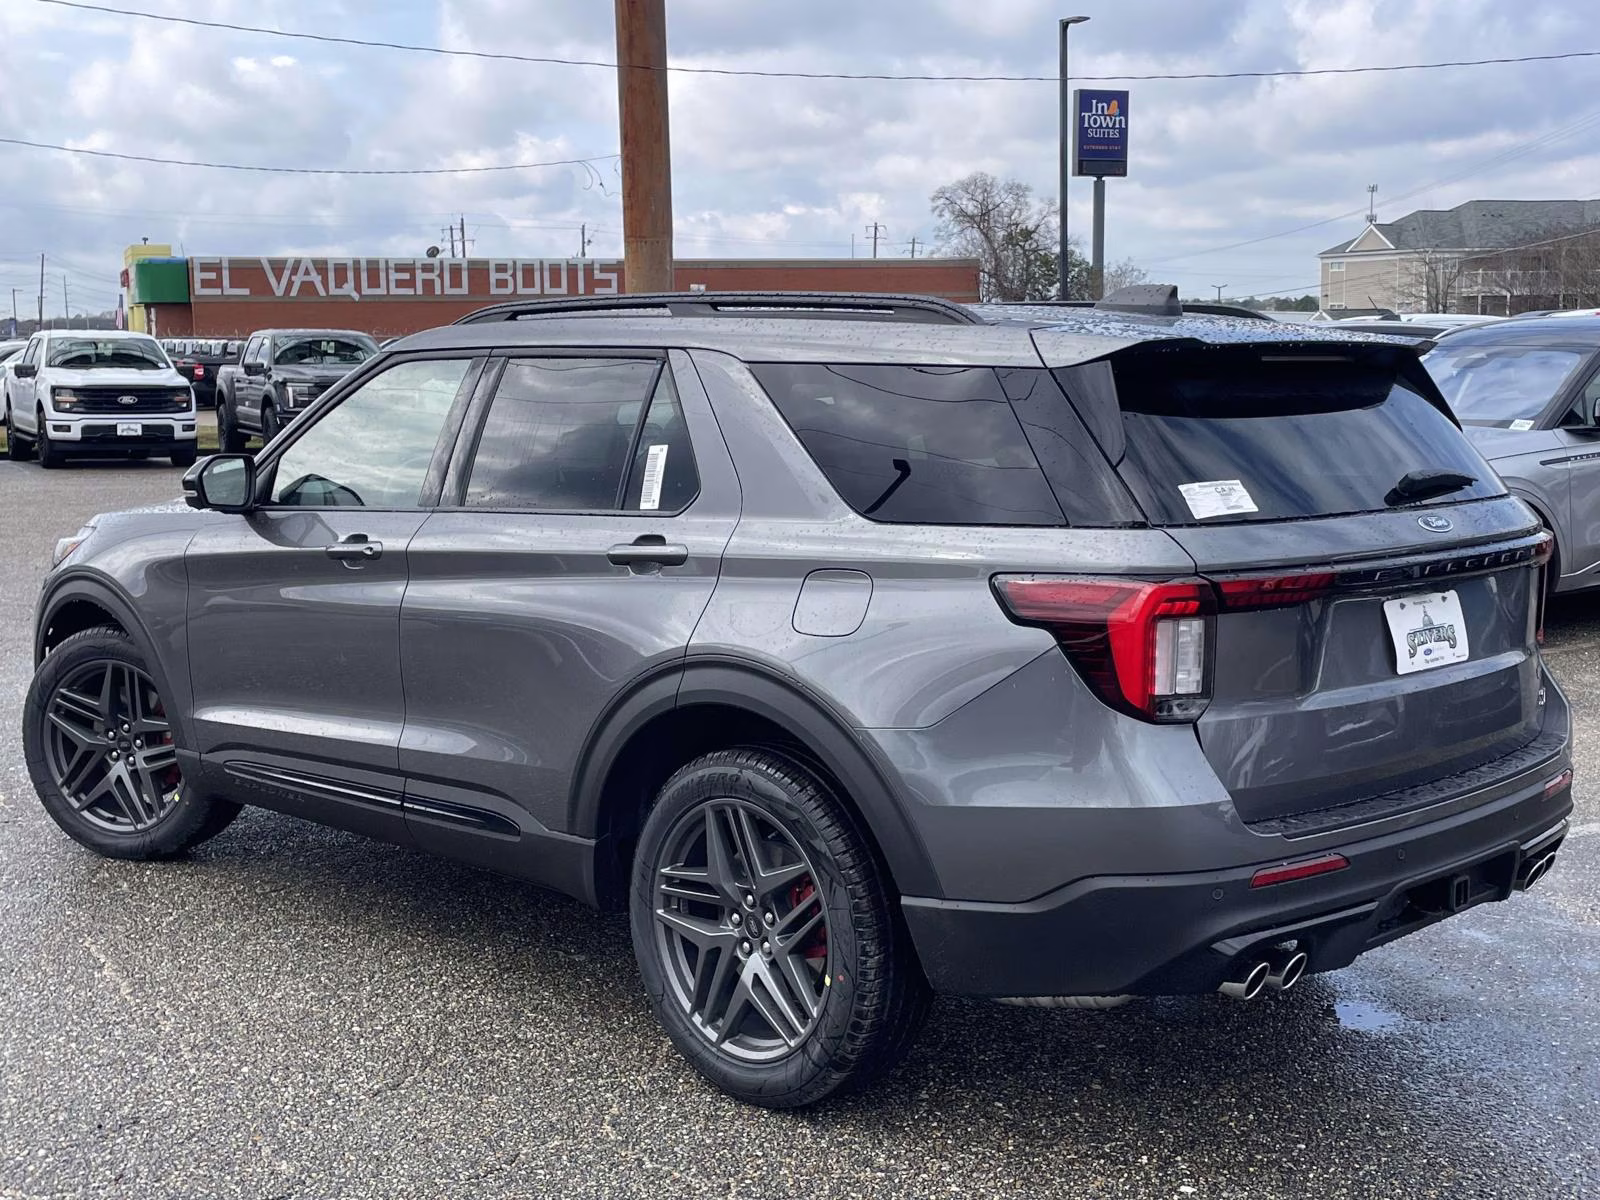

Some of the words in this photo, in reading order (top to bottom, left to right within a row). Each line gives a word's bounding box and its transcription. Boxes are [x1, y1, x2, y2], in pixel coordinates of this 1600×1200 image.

[1091, 99, 1108, 115] In
[1081, 112, 1126, 128] Town
[1087, 128, 1120, 138] SUITES
[192, 256, 250, 296] EL
[259, 256, 469, 302] VAQUERO
[489, 257, 618, 296] BOOTS
